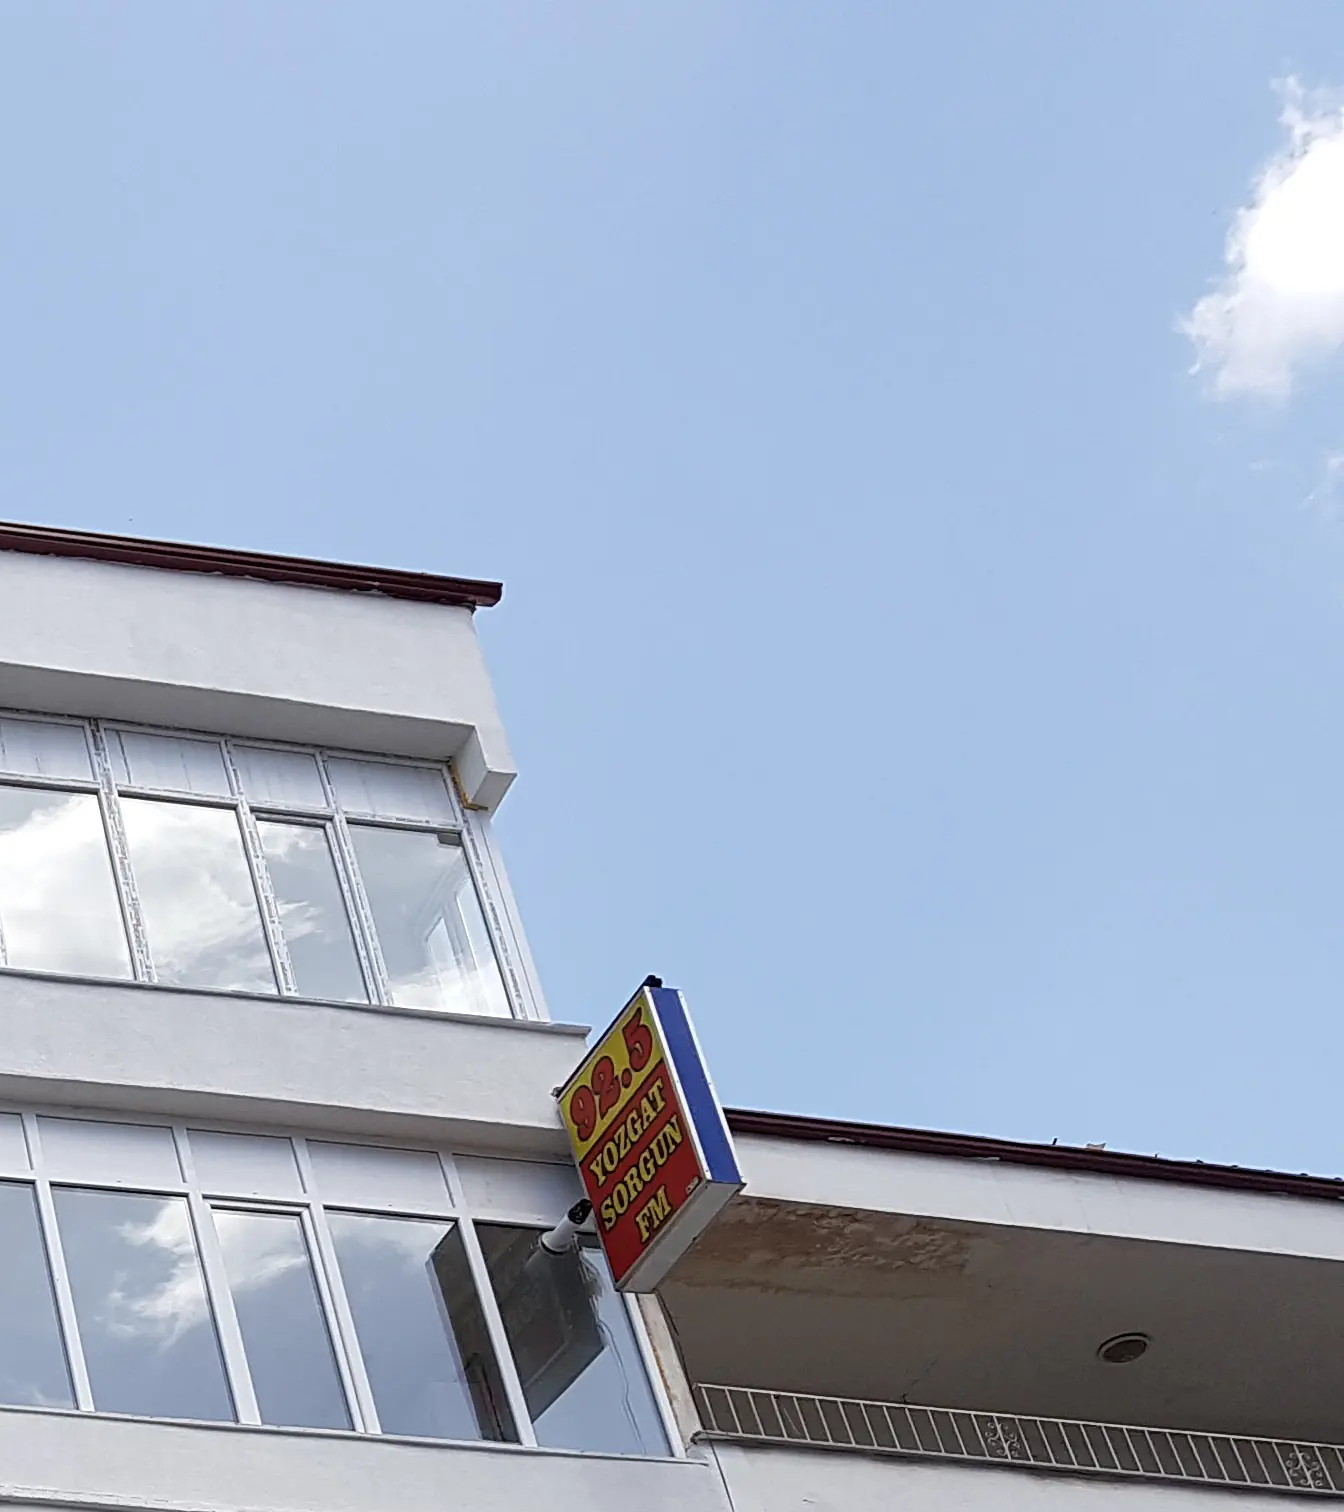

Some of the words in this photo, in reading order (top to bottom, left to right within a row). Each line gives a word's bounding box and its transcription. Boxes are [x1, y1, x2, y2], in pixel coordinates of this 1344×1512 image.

[570, 1007, 652, 1141] 92.5
[589, 1078, 668, 1186] YOZGAT
[600, 1115, 683, 1231] SORGUN
[635, 1185, 672, 1243] FM
